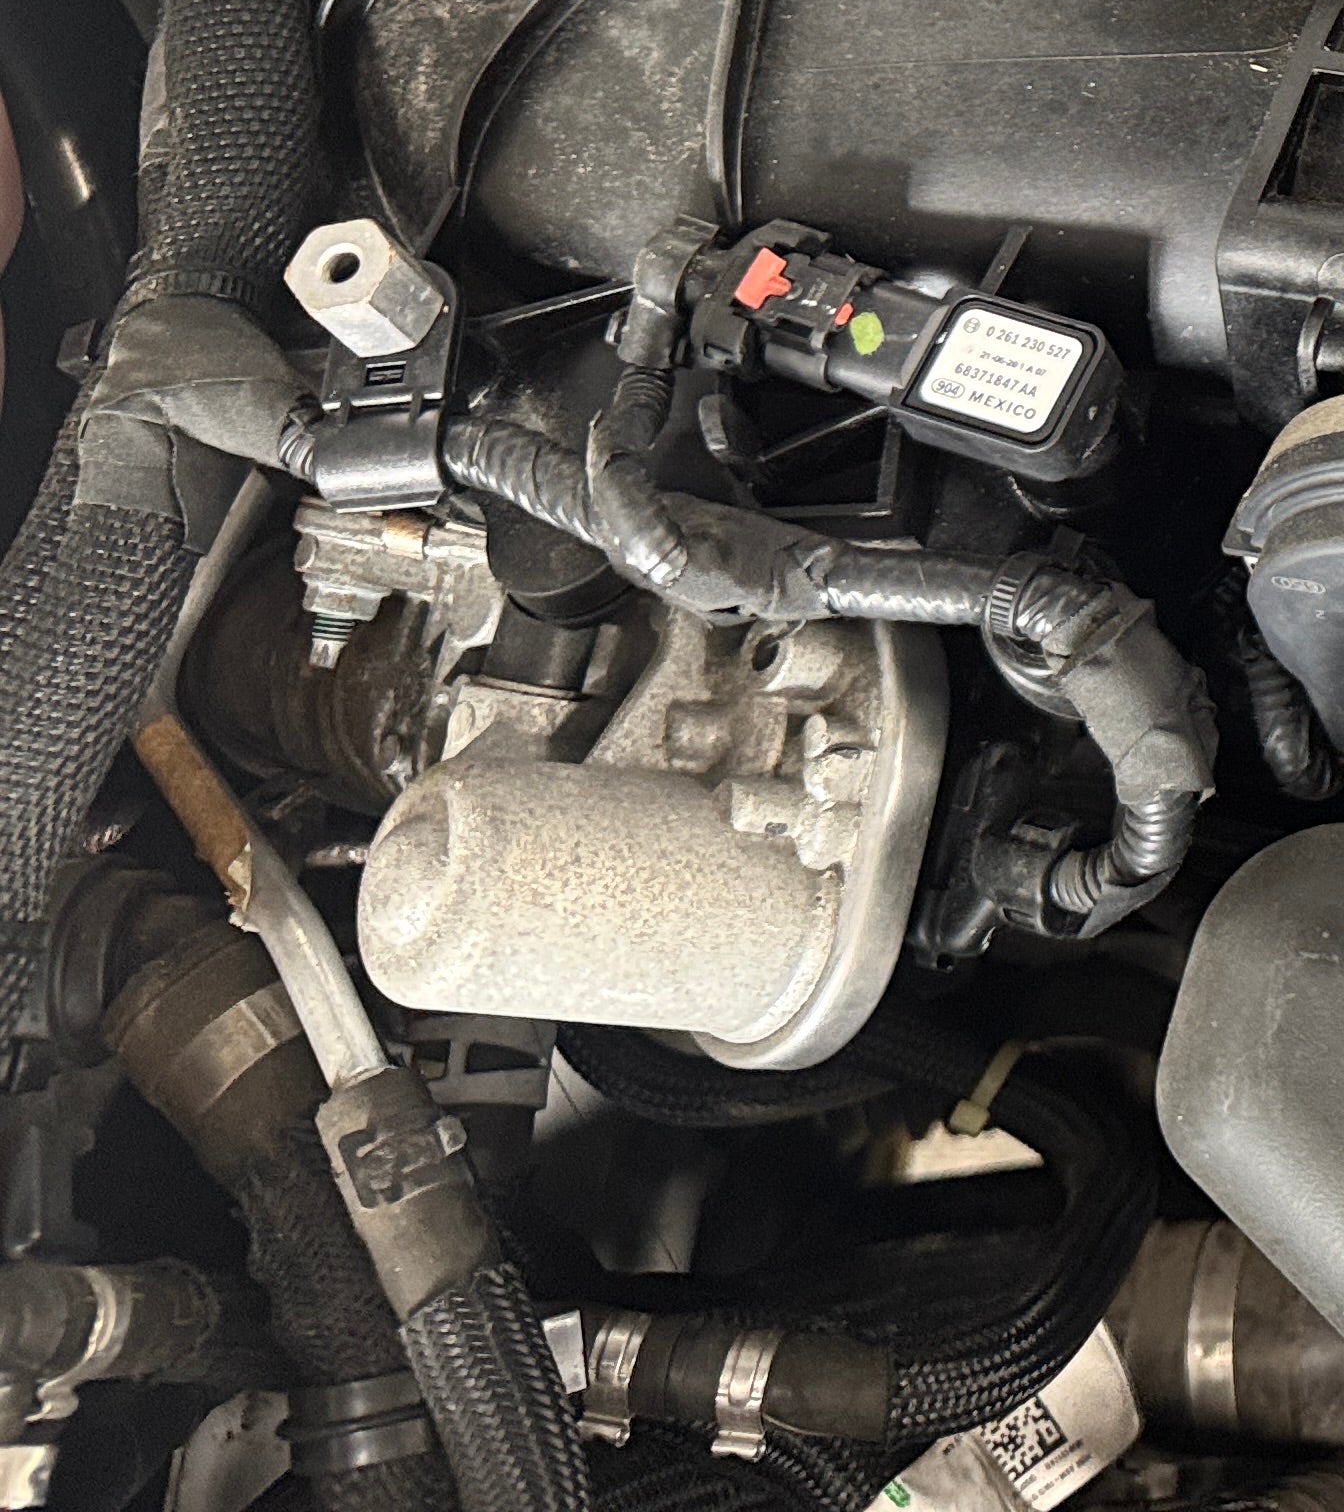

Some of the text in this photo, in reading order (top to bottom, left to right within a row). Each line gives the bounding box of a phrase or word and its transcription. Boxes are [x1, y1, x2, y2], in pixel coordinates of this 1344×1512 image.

[986, 326, 1071, 360] 0 261 230 527
[935, 380, 1037, 420] 904 MEXICO
